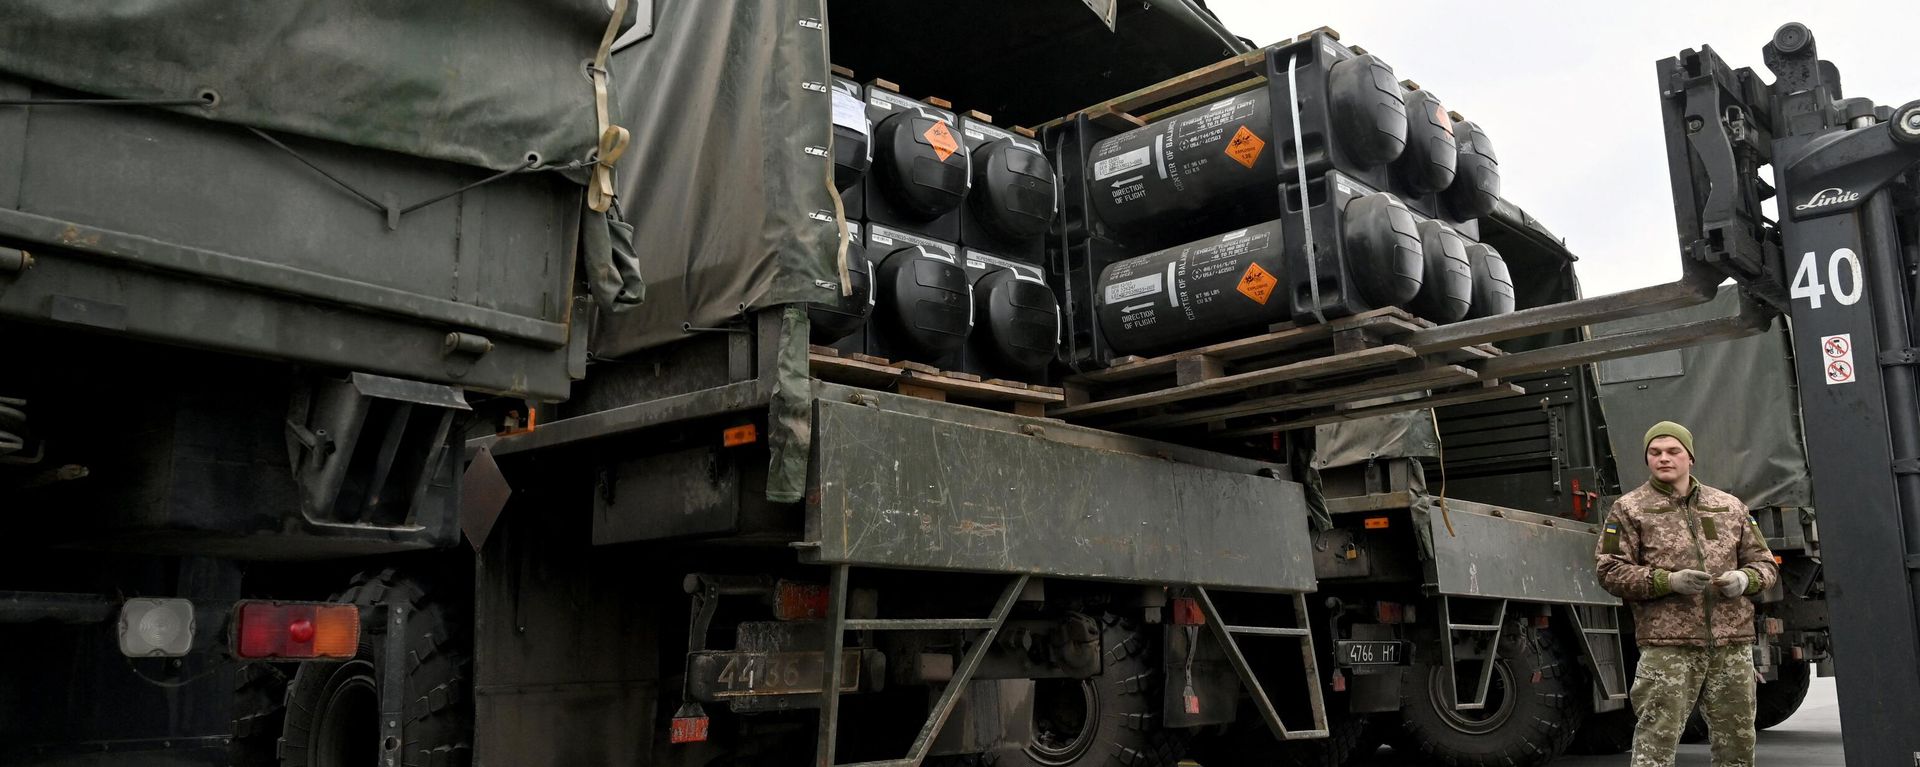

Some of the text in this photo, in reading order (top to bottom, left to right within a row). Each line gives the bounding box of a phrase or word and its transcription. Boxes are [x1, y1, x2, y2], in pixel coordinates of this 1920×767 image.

[1166, 150, 1174, 161] OF
[1169, 163, 1184, 192] CENTER
[1112, 182, 1145, 199] DIRECTION
[1114, 189, 1147, 205] OF FLIGHT
[1795, 187, 1860, 211] Linde
[1178, 278, 1186, 289] OF
[1790, 247, 1863, 310] 40
[1180, 290, 1195, 321] CENTER
[1122, 309, 1155, 323] DIRECTION
[1124, 316, 1157, 330] OF FLIGHT
[1350, 645, 1394, 662] 4766 H1
[717, 656, 800, 690] 4436
